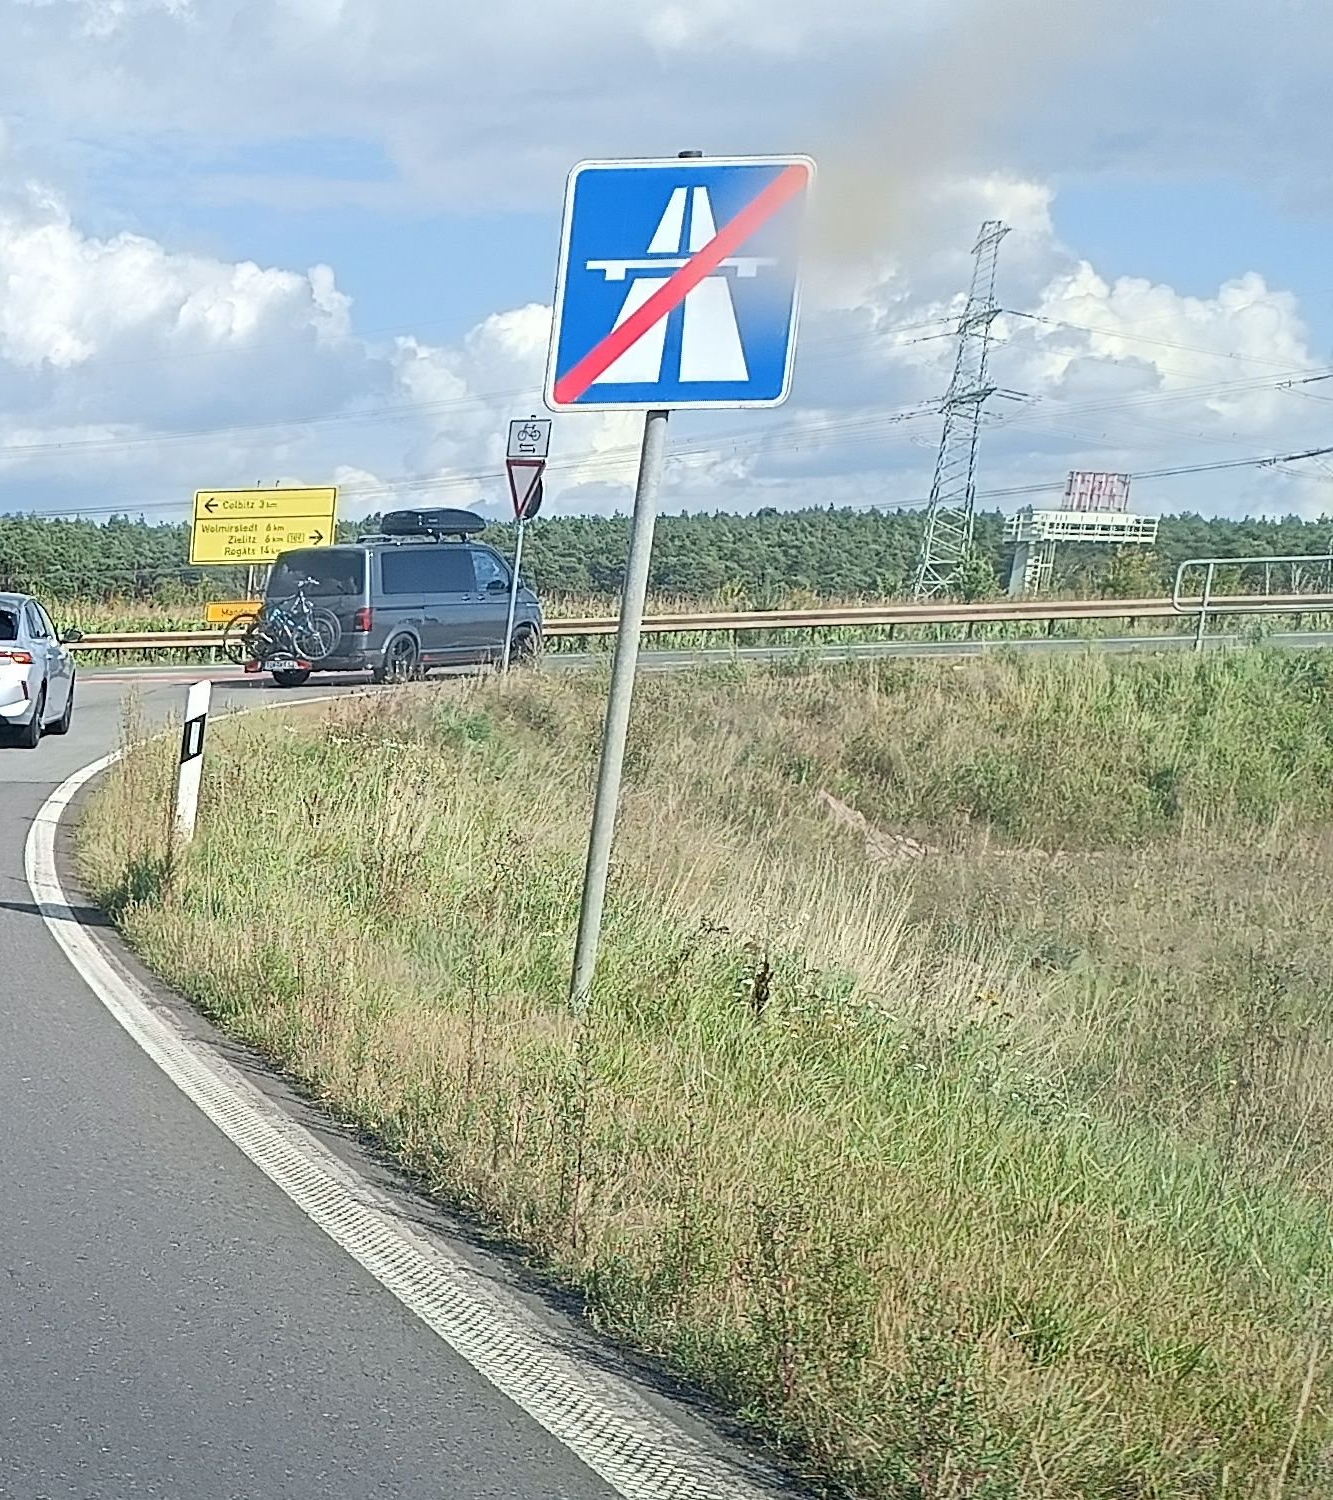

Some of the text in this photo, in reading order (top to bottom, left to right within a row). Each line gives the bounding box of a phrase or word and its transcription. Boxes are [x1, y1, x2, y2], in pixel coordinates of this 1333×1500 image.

[222, 499, 255, 510] Colbitz
[201, 523, 285, 534] Wolmirstedt 6 km
[228, 535, 257, 544] Zielitz
[264, 534, 271, 543] 6
